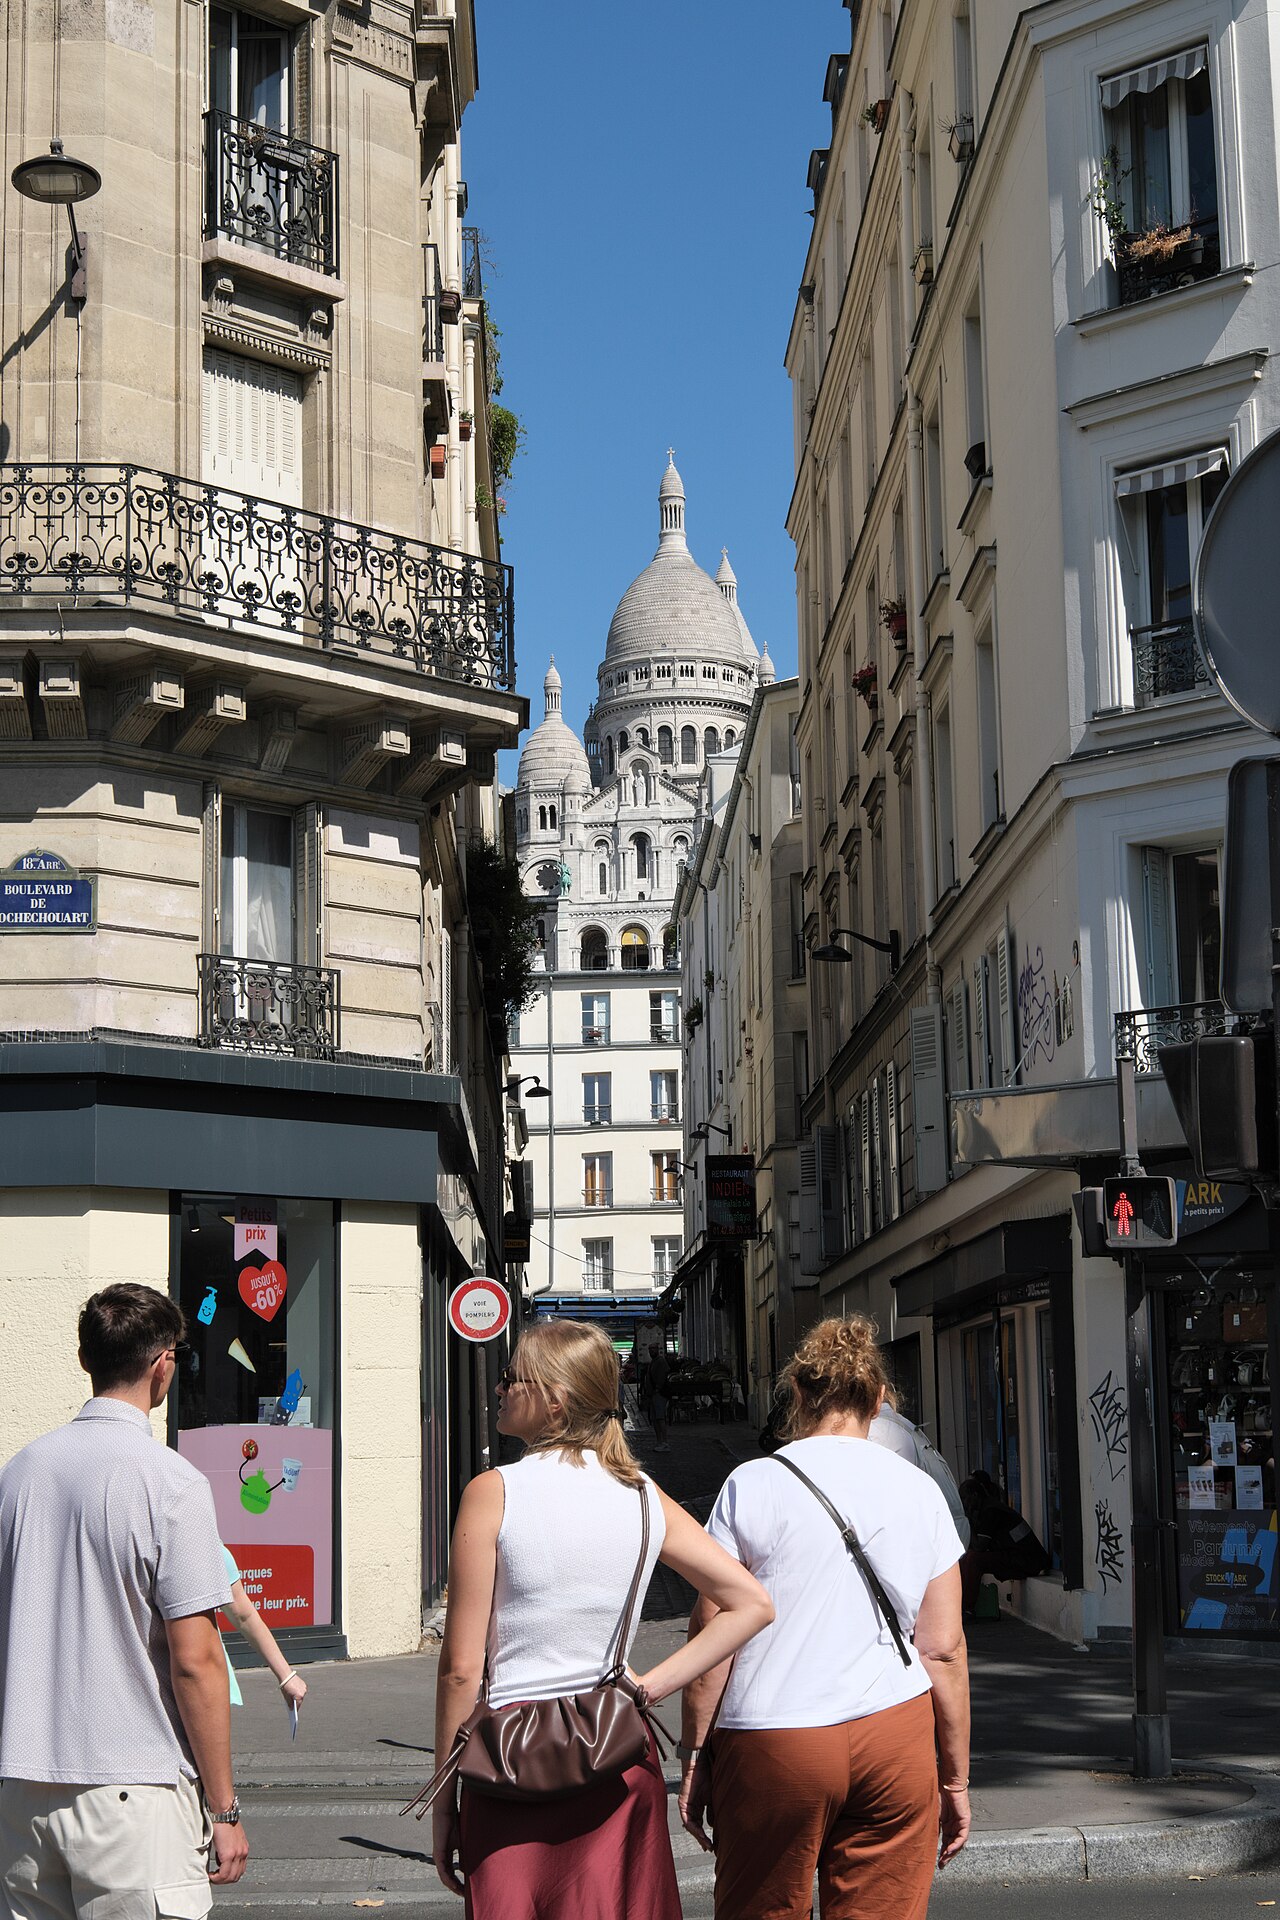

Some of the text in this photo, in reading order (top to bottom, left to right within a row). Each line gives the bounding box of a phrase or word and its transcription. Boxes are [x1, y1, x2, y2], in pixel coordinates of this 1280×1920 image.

[4, 884, 73, 895] BOULEVARD
[30, 898, 46, 909] DE
[0, 912, 89, 923] OCHECHOUART
[711, 1169, 750, 1178] RESTAURANT
[711, 1181, 751, 1199] INDIEN
[240, 1206, 272, 1222] Petits
[1190, 1207, 1208, 1217] petits
[1209, 1206, 1220, 1216] prix
[246, 1226, 267, 1242] prix
[250, 1270, 277, 1290] JUSQU'À
[251, 1283, 284, 1310] -60%
[1193, 1539, 1262, 1556] Parfums
[239, 1568, 272, 1581] arques
[244, 1582, 263, 1594] ime
[263, 1597, 284, 1610] leur
[286, 1595, 309, 1611] prix.
